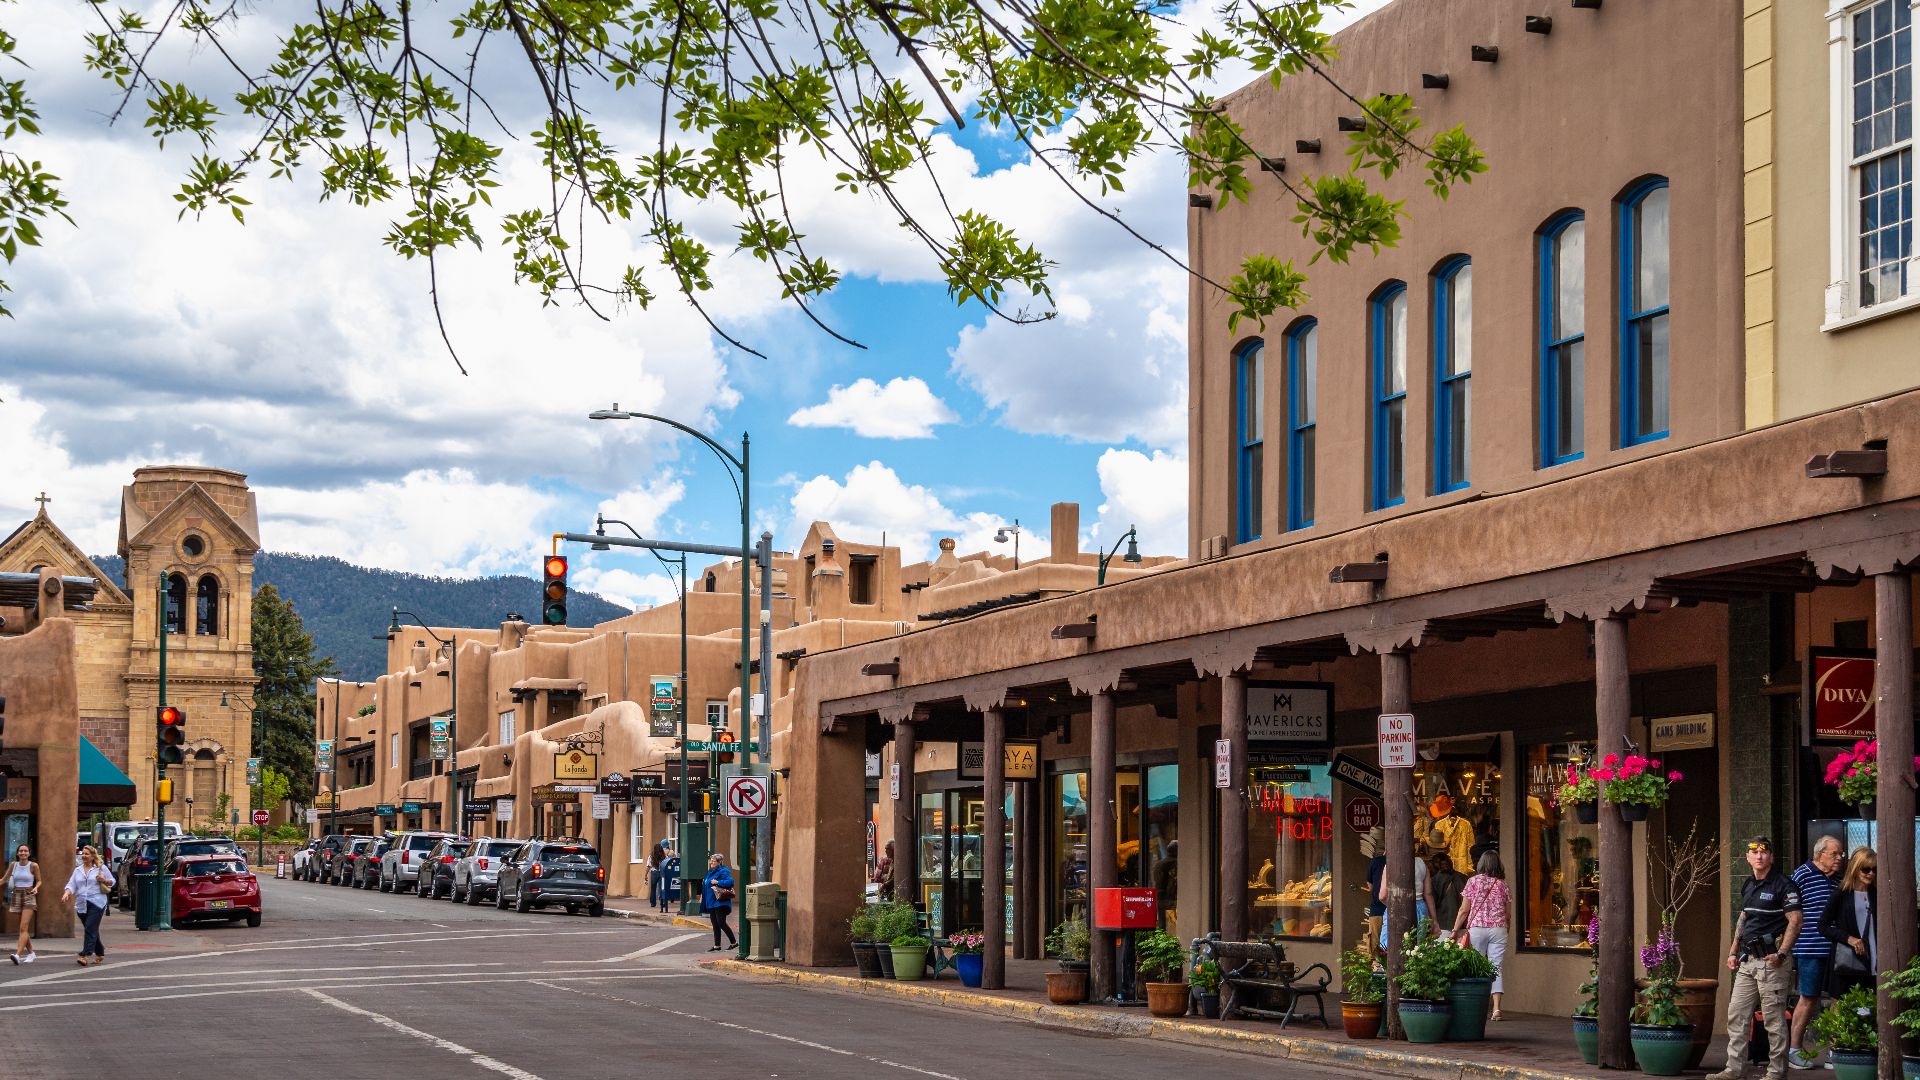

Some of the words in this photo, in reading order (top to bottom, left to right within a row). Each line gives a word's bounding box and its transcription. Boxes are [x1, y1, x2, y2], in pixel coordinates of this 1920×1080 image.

[1824, 688, 1867, 702] DIVA
[1247, 715, 1322, 727] MAVERICKS
[1390, 720, 1403, 730] NO
[1381, 733, 1412, 743] PARKING
[702, 743, 727, 752] SANTA
[1390, 755, 1404, 763] TIME
[565, 764, 570, 772] La
[571, 764, 588, 774] Fonda
[1262, 770, 1303, 779] Furniture
[1340, 764, 1358, 778] ONE
[1363, 774, 1383, 790] WAY
[1354, 804, 1372, 815] HAT
[1354, 816, 1372, 827] BAR
[1277, 816, 1316, 840] Hot
